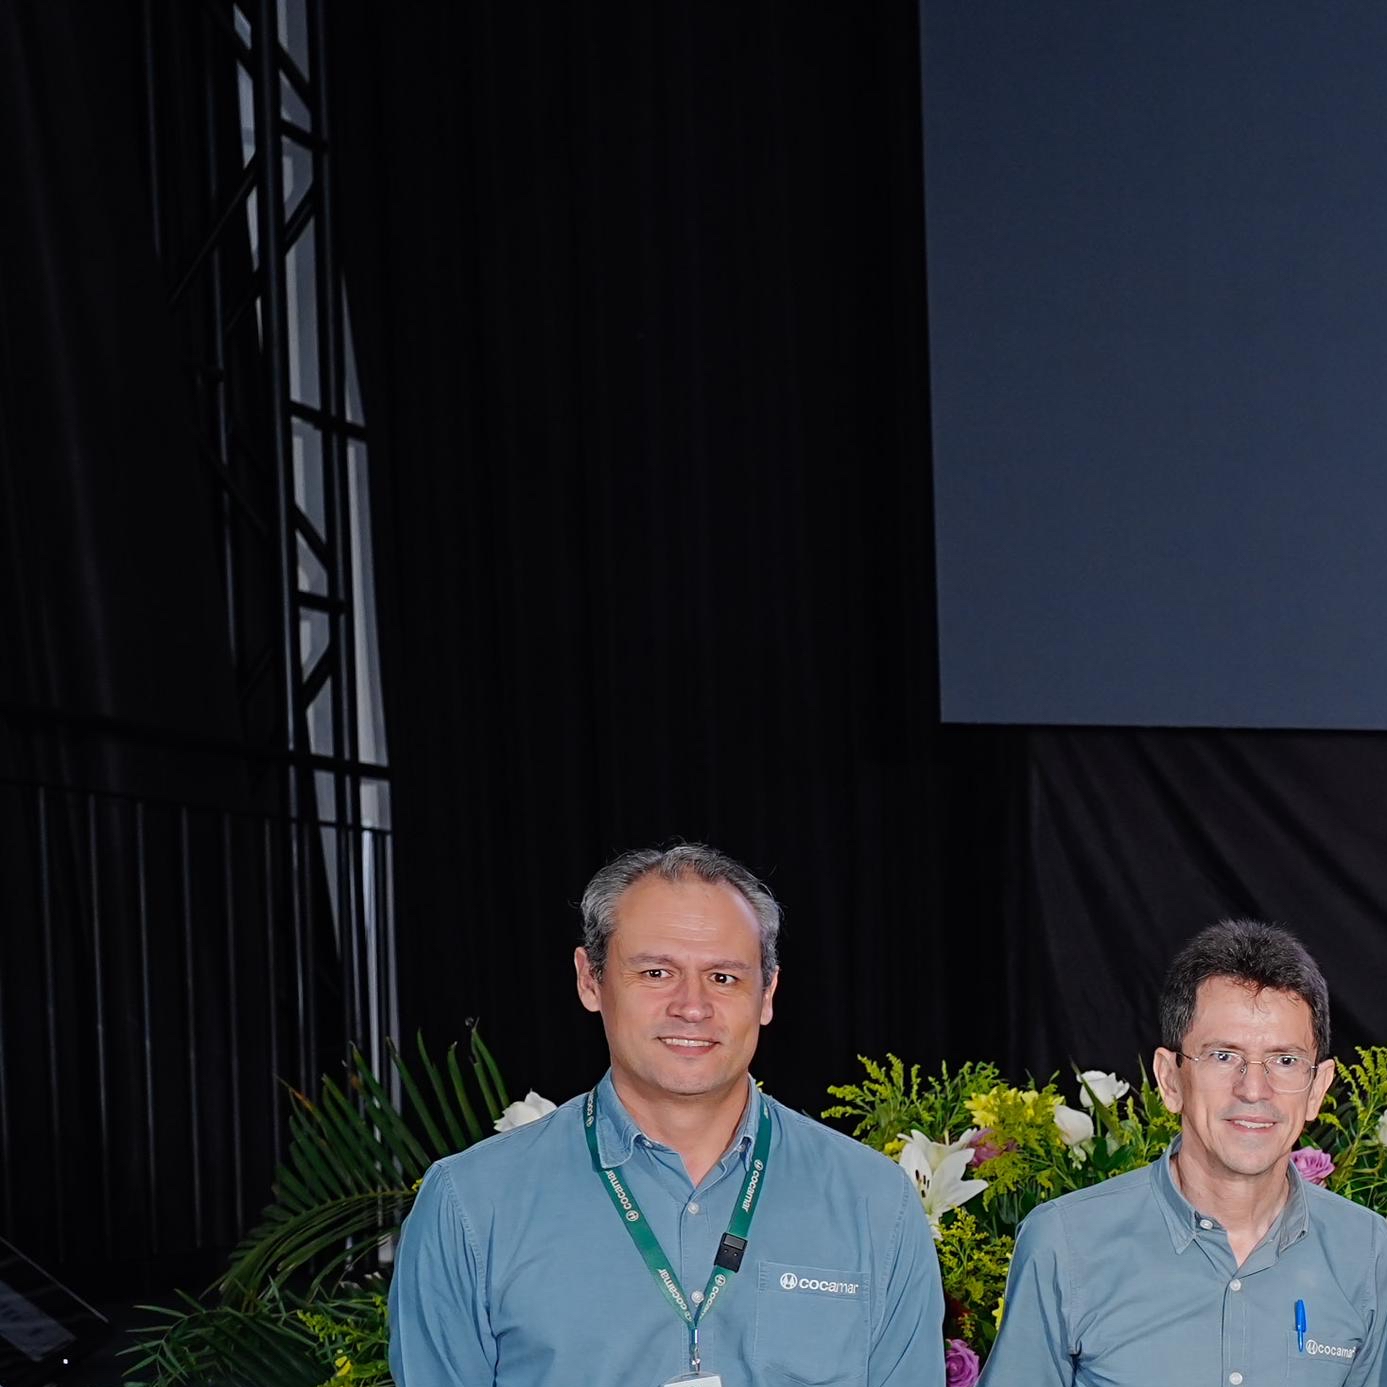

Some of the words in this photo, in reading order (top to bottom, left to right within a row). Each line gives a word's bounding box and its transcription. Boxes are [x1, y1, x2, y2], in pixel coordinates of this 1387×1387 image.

[742, 1170, 760, 1213] cocamar
[657, 1269, 688, 1310] cocamar
[799, 1277, 859, 1295] cocamar
